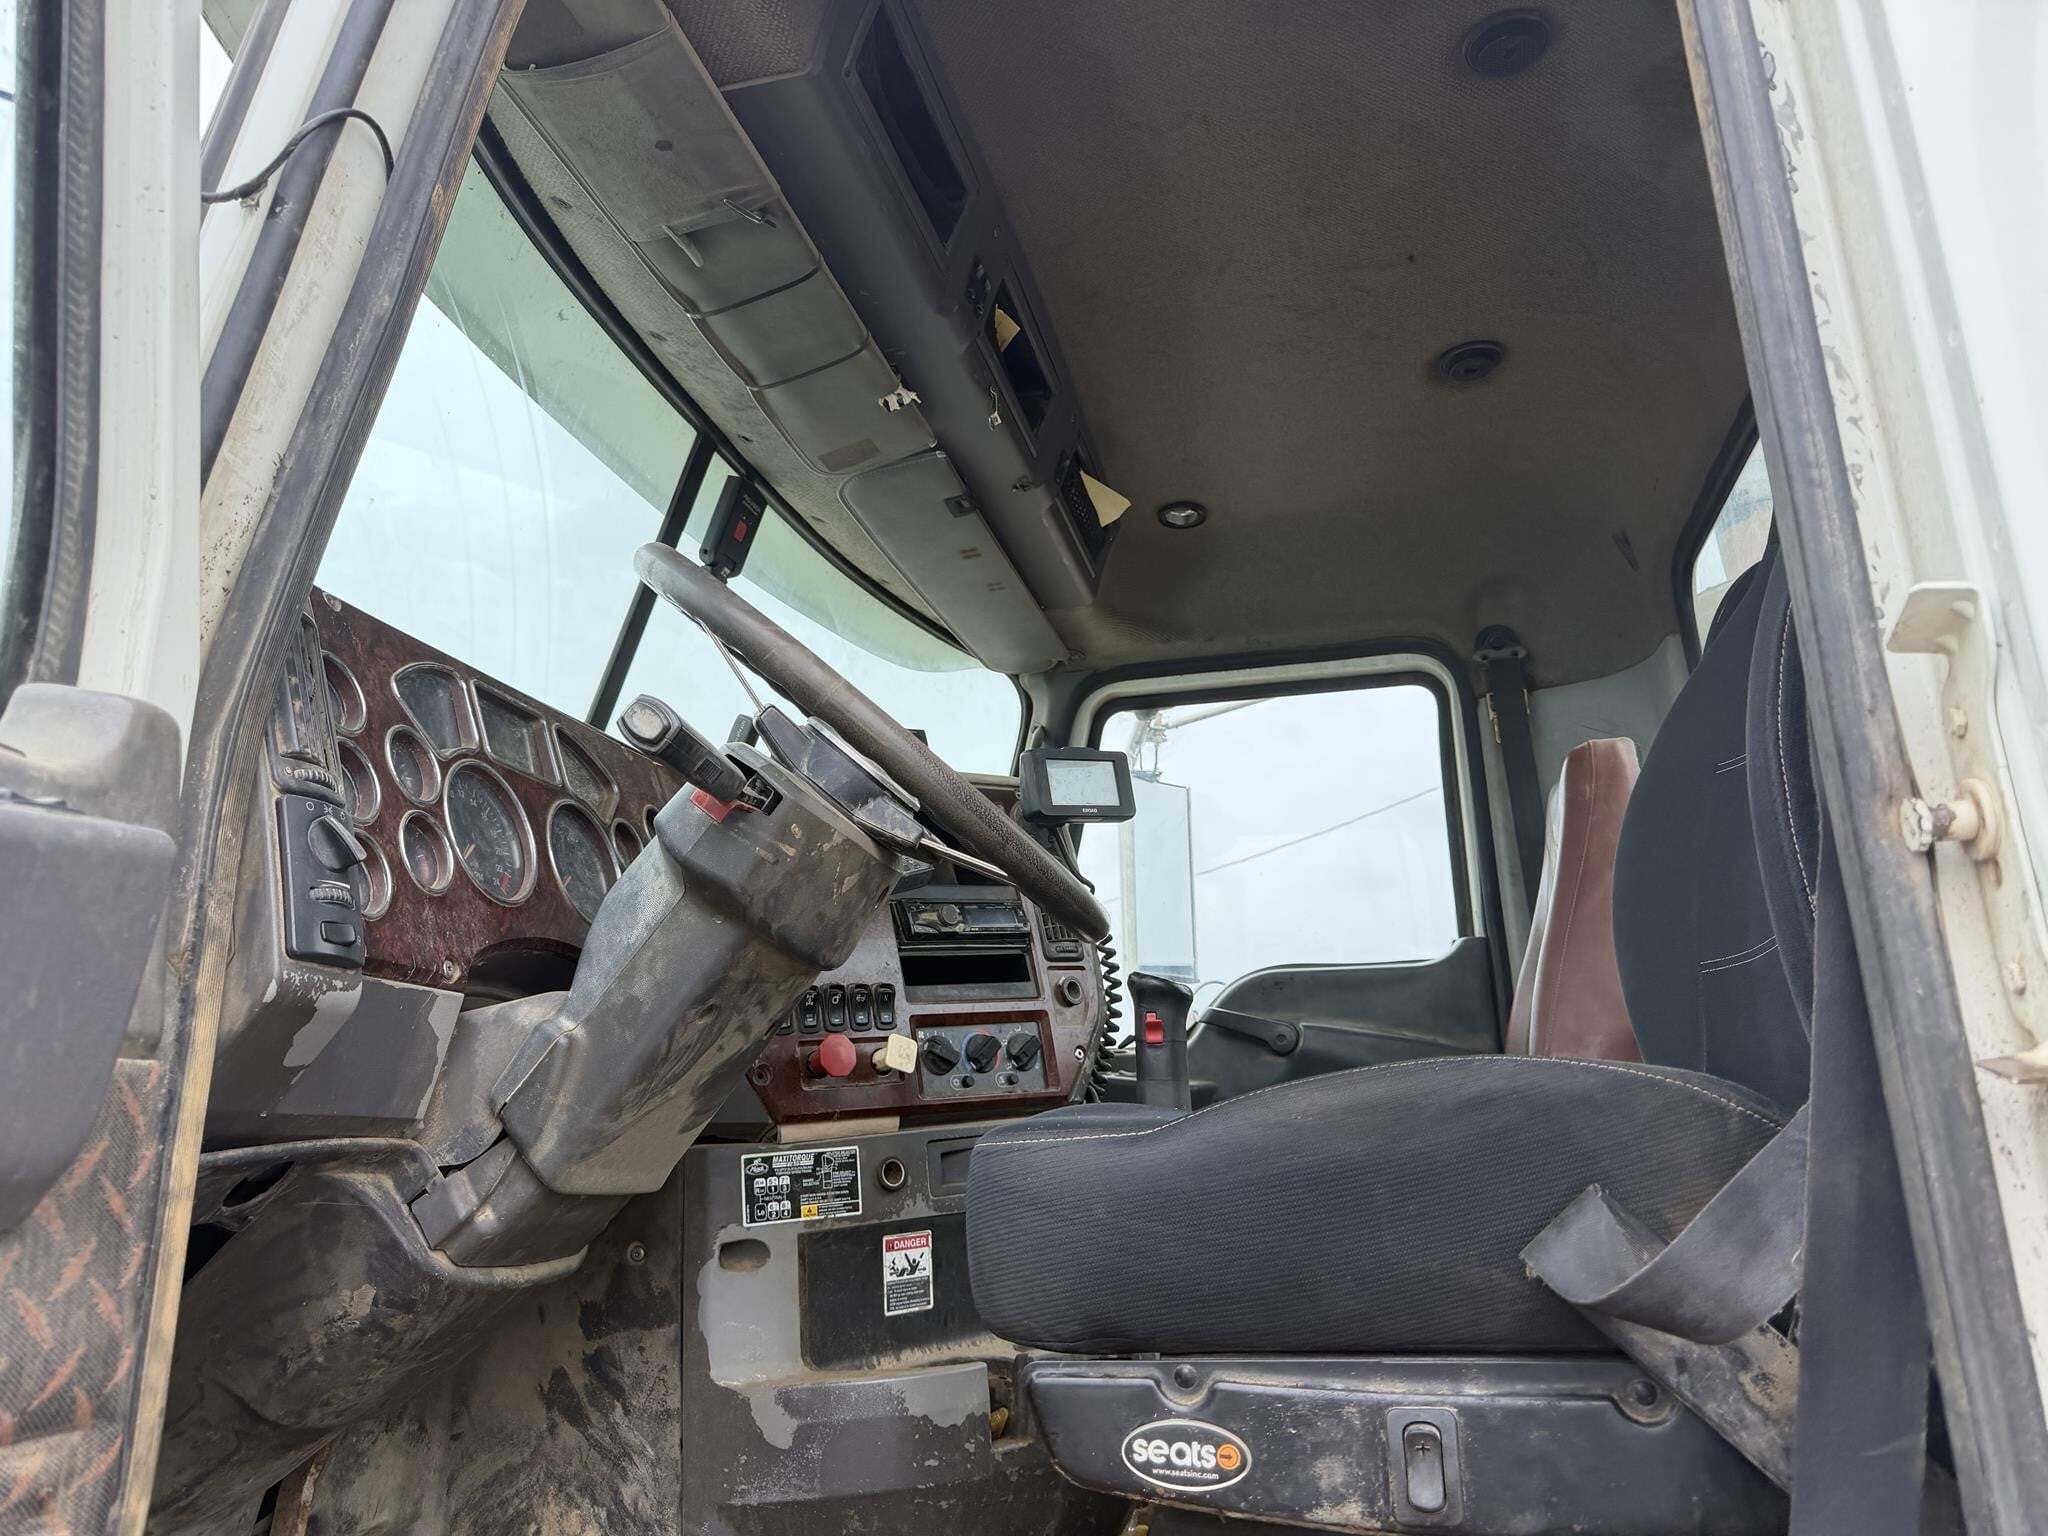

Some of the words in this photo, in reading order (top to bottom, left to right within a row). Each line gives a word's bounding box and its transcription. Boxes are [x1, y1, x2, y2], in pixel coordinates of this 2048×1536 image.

[772, 1153, 815, 1164] MAXITORQUE
[894, 1237, 927, 1250] DANGER
[1132, 1438, 1217, 1469] seats
[1152, 1468, 1220, 1480] www.seatsinc.com
